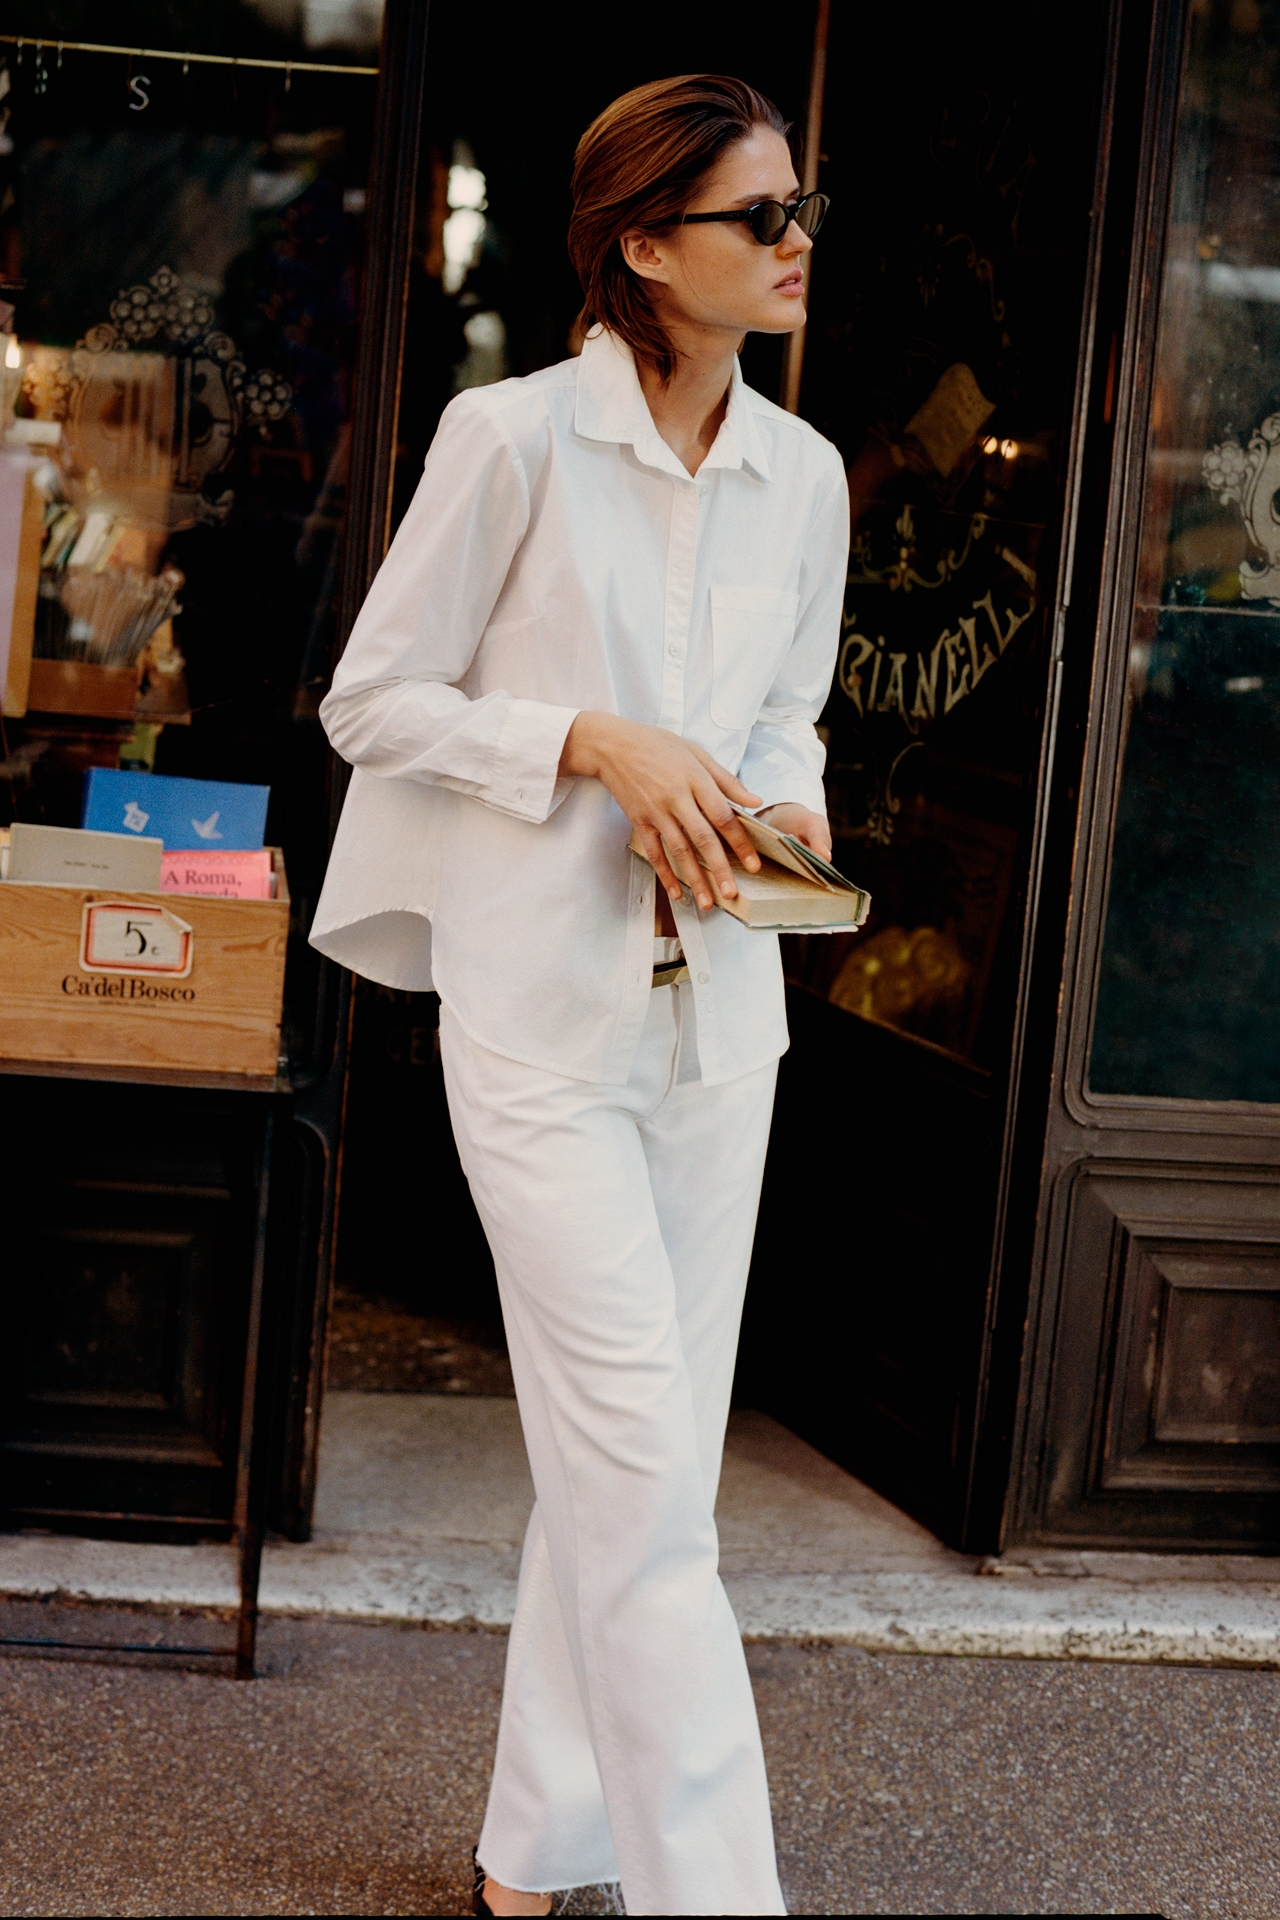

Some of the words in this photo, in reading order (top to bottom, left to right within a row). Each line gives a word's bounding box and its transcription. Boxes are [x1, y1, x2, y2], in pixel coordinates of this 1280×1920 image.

[164, 870, 180, 885] A
[185, 869, 242, 887] Roma,
[129, 979, 196, 1002] Bosco
